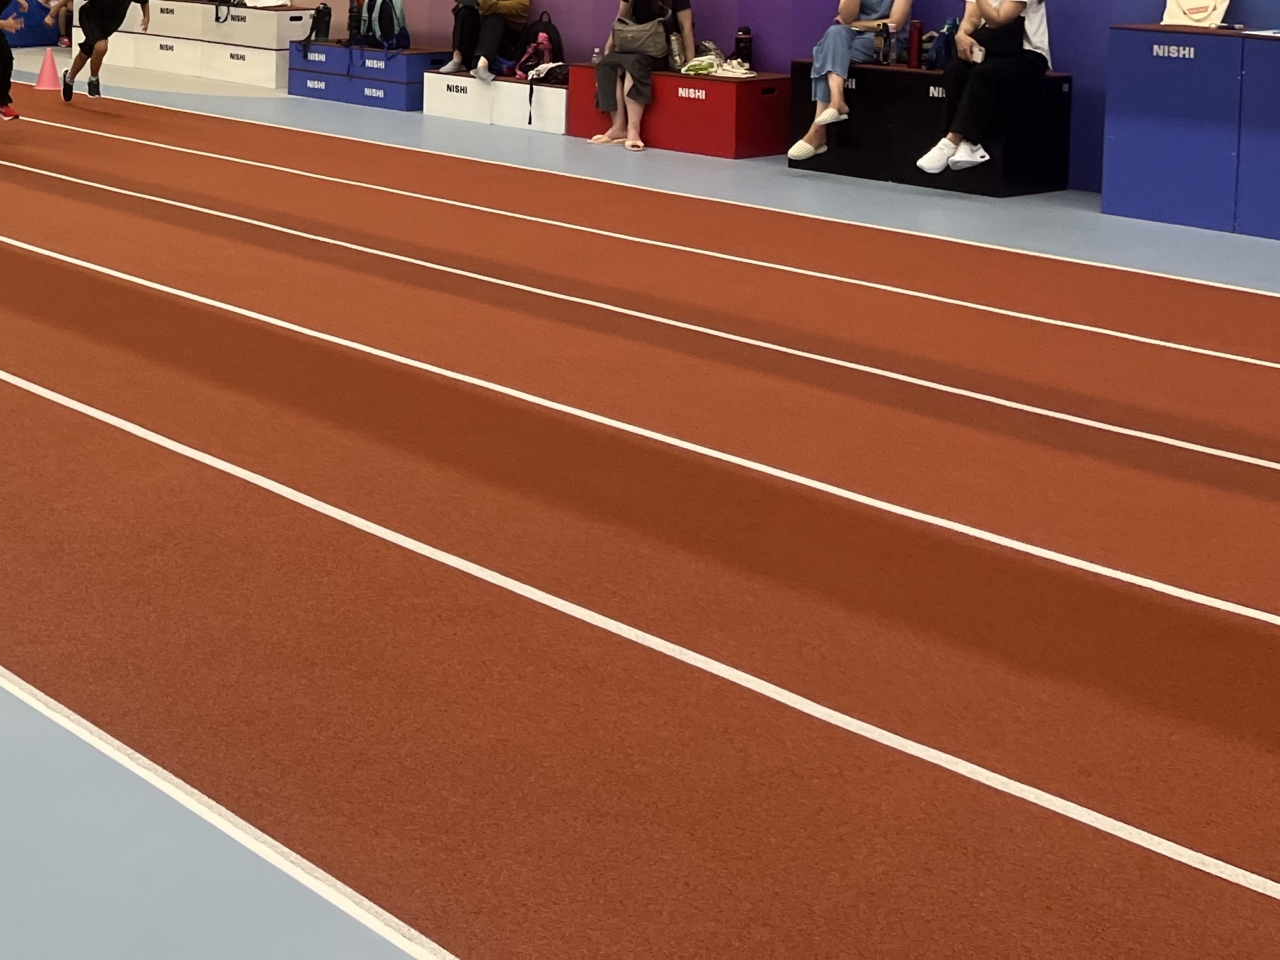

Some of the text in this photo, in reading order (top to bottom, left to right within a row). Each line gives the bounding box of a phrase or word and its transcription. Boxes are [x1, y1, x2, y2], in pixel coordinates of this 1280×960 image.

[230, 14, 247, 22] NISHI
[1153, 45, 1195, 58] NISHI
[230, 53, 246, 61] NISHI
[365, 59, 385, 69] NISHI
[307, 79, 326, 90] NISHI
[446, 84, 468, 94] NISHI
[364, 87, 384, 98] NISHI
[678, 87, 706, 100] NISHI
